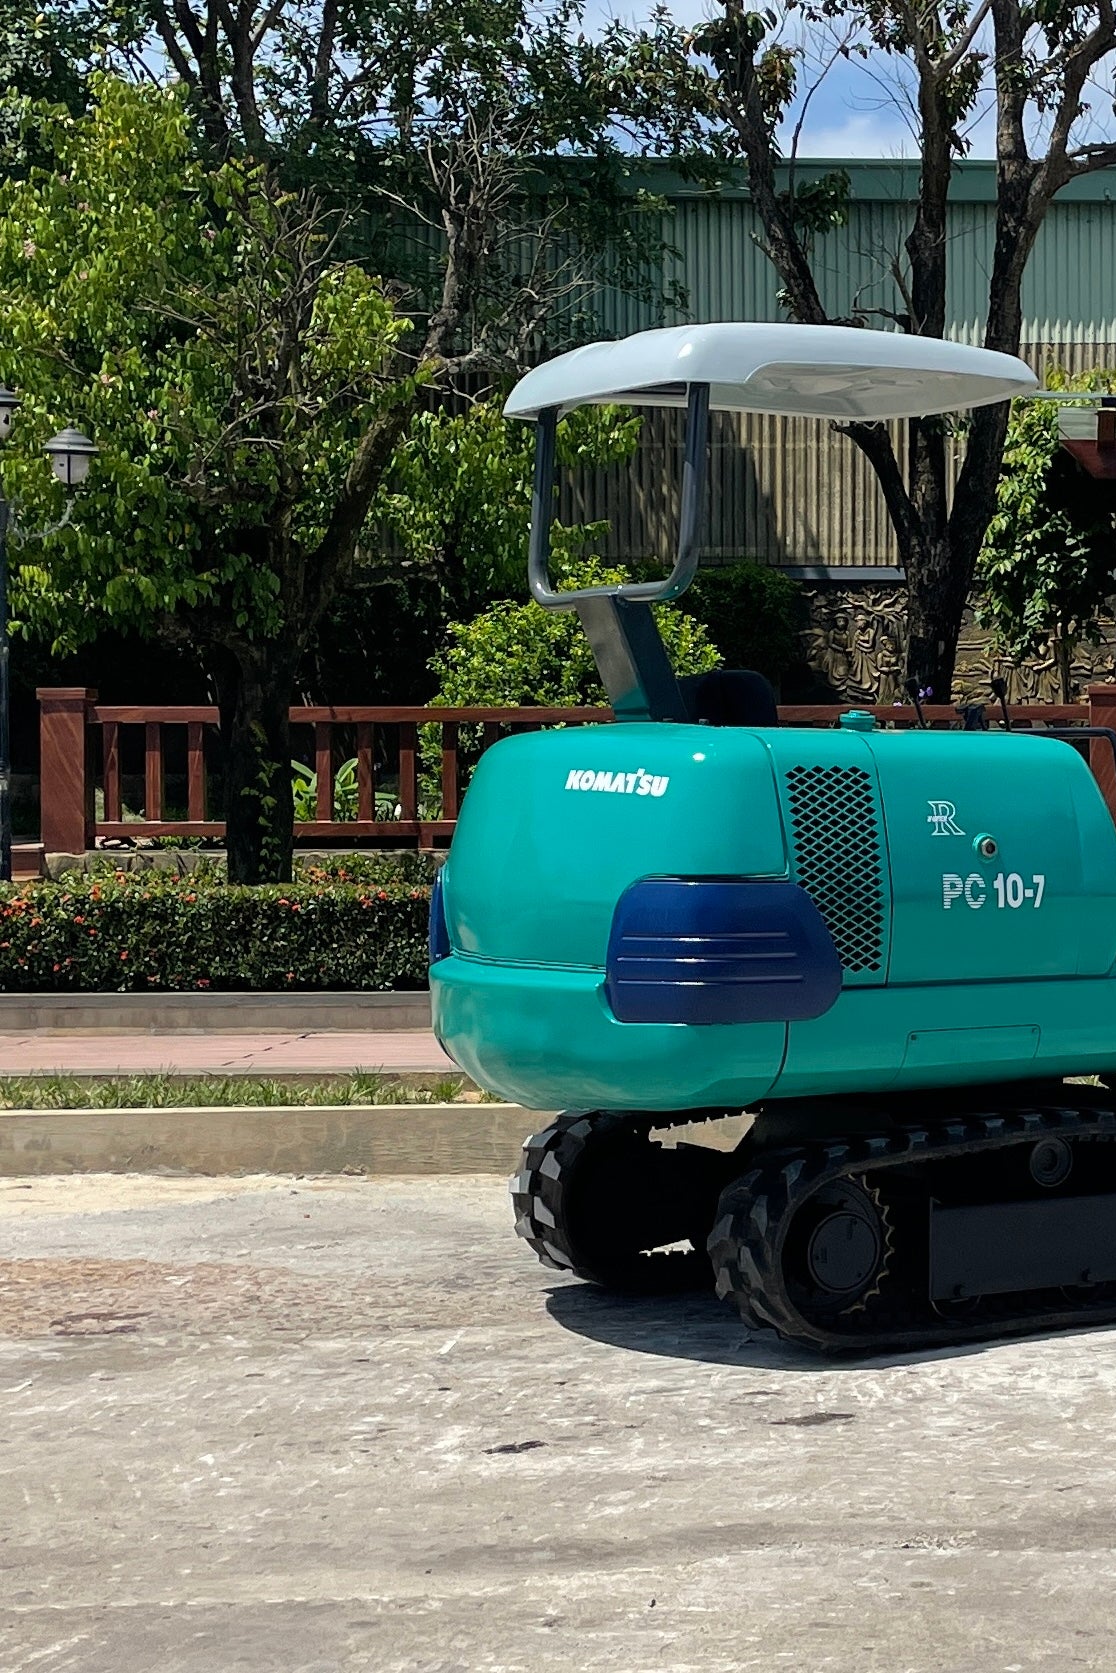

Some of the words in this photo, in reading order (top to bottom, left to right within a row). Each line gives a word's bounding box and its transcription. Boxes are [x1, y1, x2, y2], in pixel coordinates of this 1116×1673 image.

[564, 767, 670, 797] KOMATSU
[942, 872, 987, 909] PC
[993, 872, 1045, 909] 10-7
